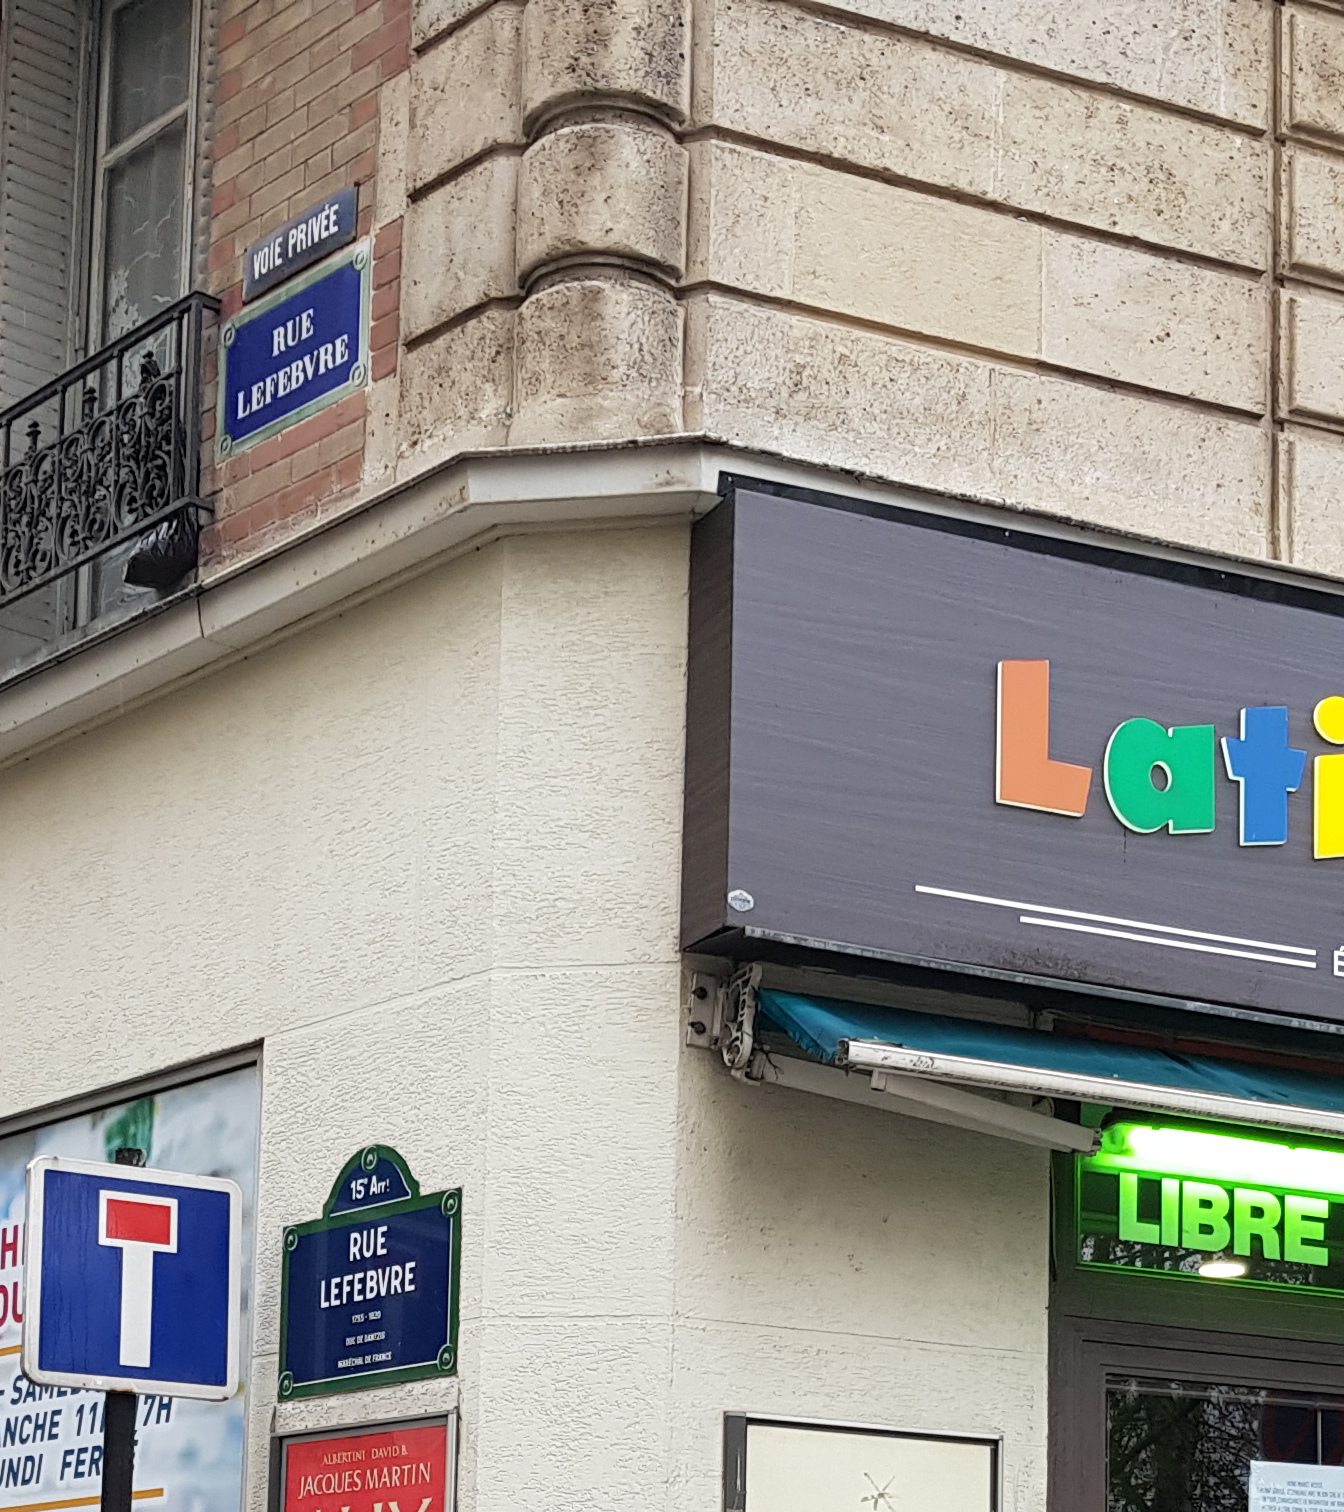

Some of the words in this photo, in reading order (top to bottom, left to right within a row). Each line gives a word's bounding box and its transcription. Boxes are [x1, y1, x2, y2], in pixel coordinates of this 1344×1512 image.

[253, 237, 283, 280] VOIE
[288, 203, 339, 258] PRIVÉE
[272, 308, 314, 357] RUE
[236, 334, 349, 420] LEFEBVRE
[349, 1225, 388, 1261] RUE
[1119, 1172, 1329, 1267] LIBRE
[320, 1261, 416, 1309] LEFEBVRE
[322, 1449, 366, 1466] ALBERTINI
[371, 1446, 398, 1459] DAVID
[298, 1469, 362, 1499] JACQUES
[365, 1462, 432, 1490] MARTIN
